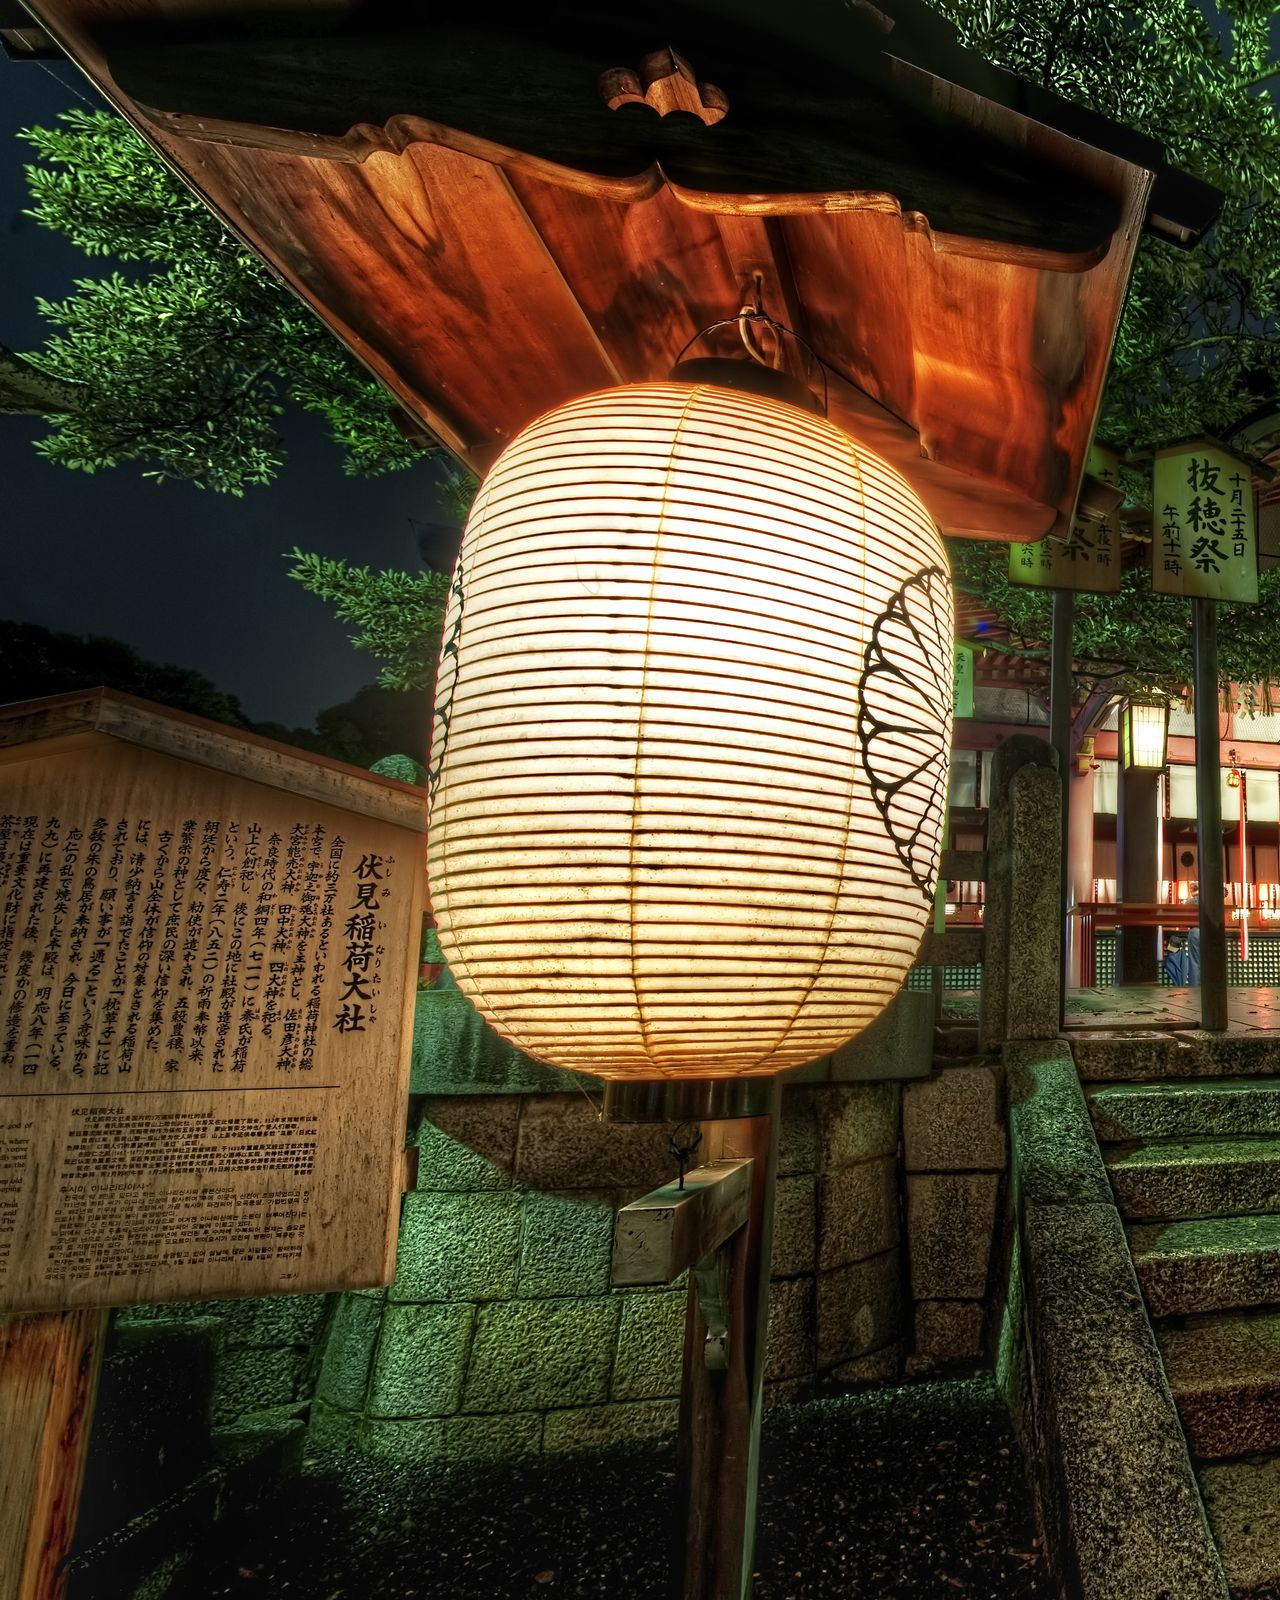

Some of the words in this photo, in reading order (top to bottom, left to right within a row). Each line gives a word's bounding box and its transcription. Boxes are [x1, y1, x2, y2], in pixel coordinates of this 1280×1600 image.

[1162, 504, 1182, 576] 午前十一時
[1185, 458, 1229, 574] 抜穂祭
[1229, 472, 1248, 557] 十月二十五日
[118, 830, 174, 1073] 古くから山全体が信仰の対象とされる稲荷山
[298, 835, 346, 1071] 全国に約三万社あるといわれる稲荷神社の総
[332, 853, 384, 1034] 伏見稲荷大社
